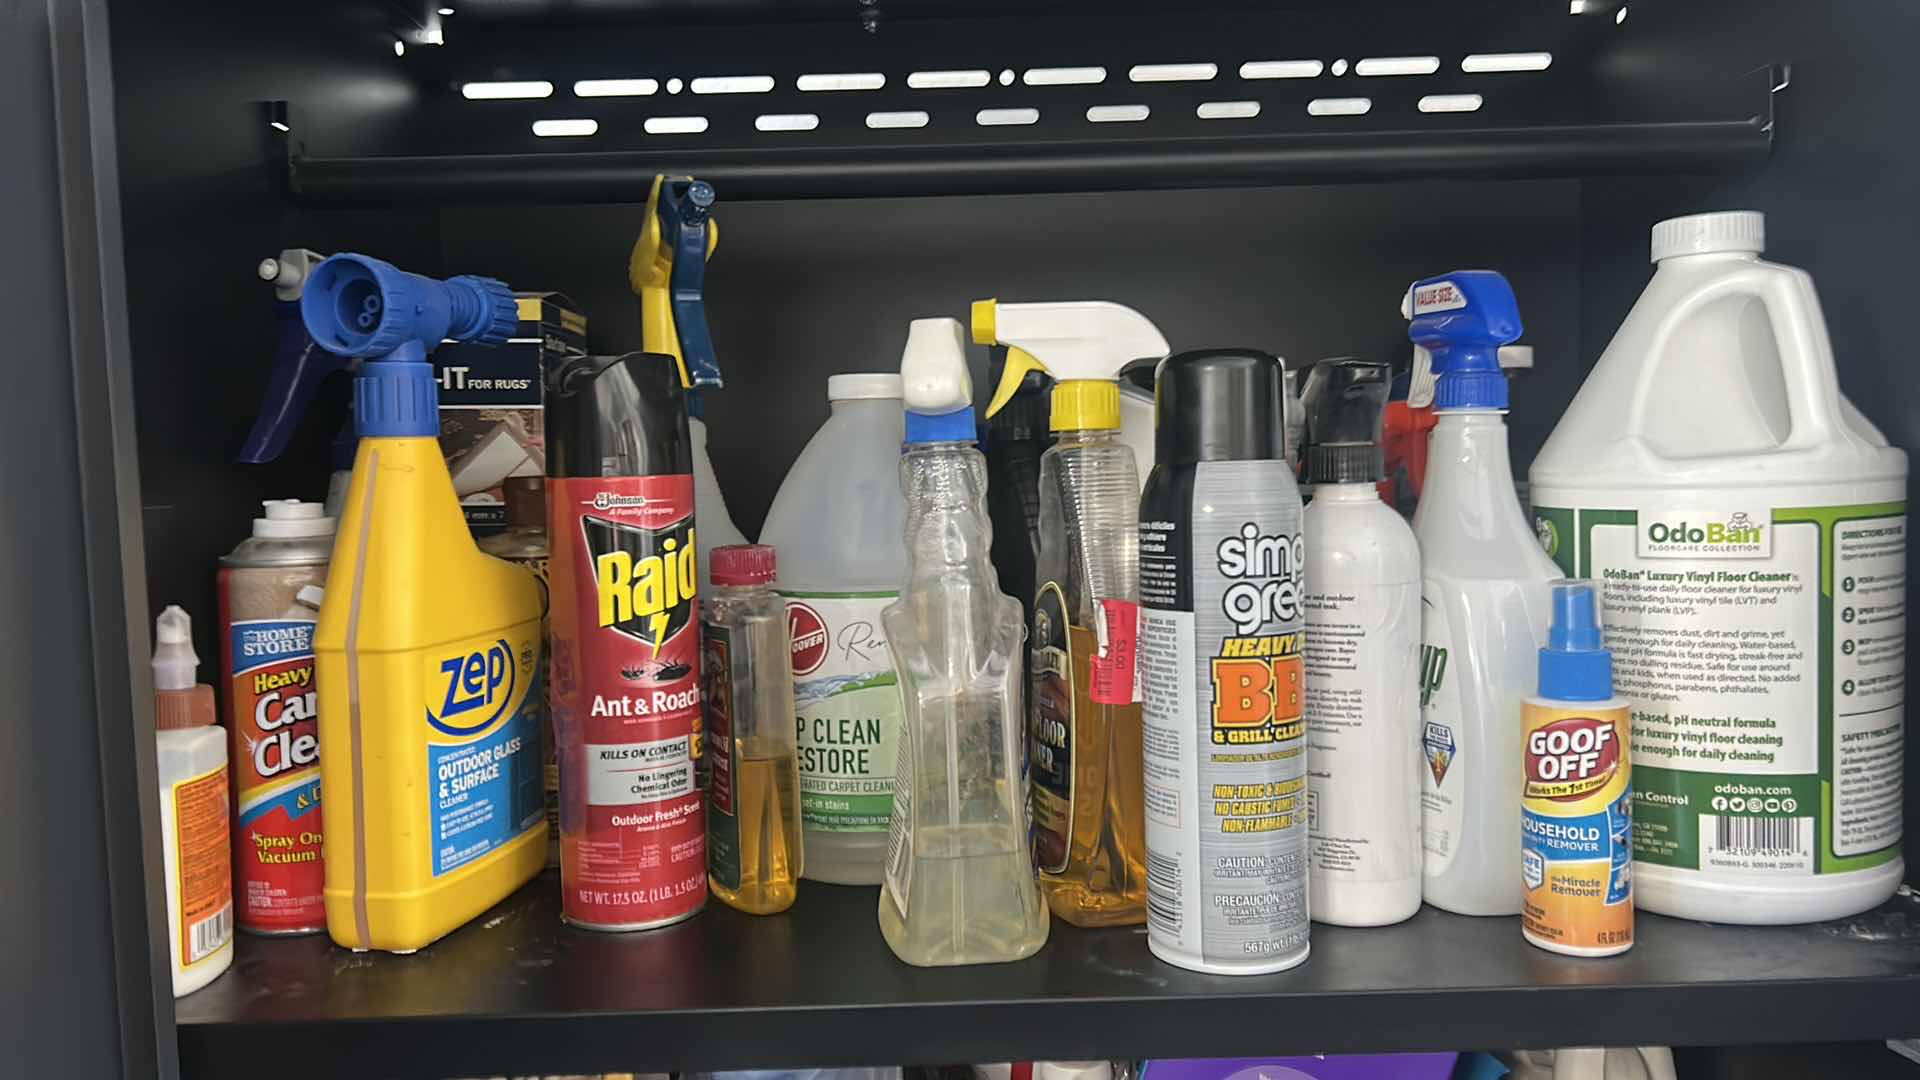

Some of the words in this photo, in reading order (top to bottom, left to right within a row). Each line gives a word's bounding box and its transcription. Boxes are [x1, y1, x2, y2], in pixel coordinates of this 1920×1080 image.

[468, 380, 492, 389] FOR
[597, 528, 696, 628] Raid
[1647, 570, 1684, 584] Luxury
[1686, 571, 1715, 585] Vinyl
[1717, 572, 1746, 582] Floor
[1748, 571, 1791, 582] Cleaner
[1660, 584, 1680, 594] daily
[1703, 585, 1737, 594] cleaner
[1740, 585, 1752, 593] for
[1753, 585, 1781, 595] luxury
[1782, 584, 1803, 595] vinyl
[1627, 593, 1665, 605] including
[1666, 595, 1694, 605] luxury
[1695, 596, 1717, 607] vinyl
[1735, 596, 1758, 607] (LVT)
[1760, 597, 1778, 606] and
[1647, 605, 1672, 614] plank
[256, 627, 307, 643] HOME
[1643, 629, 1679, 637] removes
[1680, 630, 1702, 638] dust,
[1704, 630, 1720, 638] dirt
[1721, 630, 1739, 638] and
[1741, 630, 1770, 640] grime,
[1771, 631, 1785, 640] yet
[244, 637, 310, 656] STORE
[1221, 633, 1297, 657] HEAVY
[1628, 638, 1660, 648] enough
[1675, 640, 1697, 649] daily
[1644, 649, 1677, 657] formula
[1679, 650, 1686, 658] is
[1687, 651, 1704, 659] fast
[1705, 652, 1737, 662] drying,
[1739, 652, 1785, 661] streak-free
[1786, 652, 1803, 660] and
[1639, 658, 1669, 668] dulling
[1706, 662, 1726, 671] Safe
[1727, 663, 1741, 671] for
[1759, 663, 1790, 671] around
[254, 666, 313, 695] Heavy
[1620, 668, 1636, 676] and
[1657, 672, 1681, 680] when
[1682, 673, 1704, 681] used
[1758, 674, 1772, 682] No
[1773, 673, 1802, 683] added
[591, 695, 633, 717] Ant
[635, 697, 650, 716] &
[1674, 715, 1689, 727] pH
[1690, 716, 1732, 728] neutral
[1733, 717, 1777, 729] formula
[813, 718, 881, 746] CLEAN
[1213, 730, 1225, 743] &
[1227, 729, 1273, 744] GRILL
[1429, 725, 1449, 738] KILLS
[1646, 727, 1680, 743] luxury
[1681, 731, 1708, 745] vinyl
[1709, 732, 1736, 745] floor
[1737, 733, 1784, 748] cleaning
[1530, 724, 1612, 755] GOOF
[600, 749, 629, 761] KILLS
[630, 748, 648, 760] ON
[648, 740, 689, 757] CONTACT
[1641, 744, 1681, 759] enough
[1682, 746, 1698, 758] for
[1699, 748, 1727, 763] daily
[1728, 749, 1775, 764] cleaning
[439, 750, 493, 781] OUTDOOR
[493, 737, 521, 761] GLASS
[1538, 752, 1599, 780] OFF
[439, 782, 449, 799] &
[451, 763, 500, 795] SURFACE
[638, 773, 651, 783] No
[652, 767, 688, 782] Lingering
[630, 780, 670, 795] Chemical
[828, 780, 860, 793] CARPET
[1213, 784, 1266, 799] NON-TOXIC
[1552, 786, 1567, 795] The
[1714, 782, 1793, 796] odoban.com
[296, 793, 310, 809] &
[1646, 791, 1689, 806] Control
[1215, 801, 1230, 816] NO
[1231, 800, 1272, 816] CAUSTIC
[611, 813, 654, 827] Outdoor
[1525, 817, 1600, 841] OUSEHOLD
[255, 832, 295, 850] Spray
[299, 832, 323, 845] On
[1546, 839, 1600, 852] REMOVER
[257, 850, 317, 864] Vacuum
[1560, 876, 1601, 888] Miracle
[579, 889, 593, 904] NET
[612, 890, 630, 905] 17.5
[1551, 883, 1601, 898] Remover
